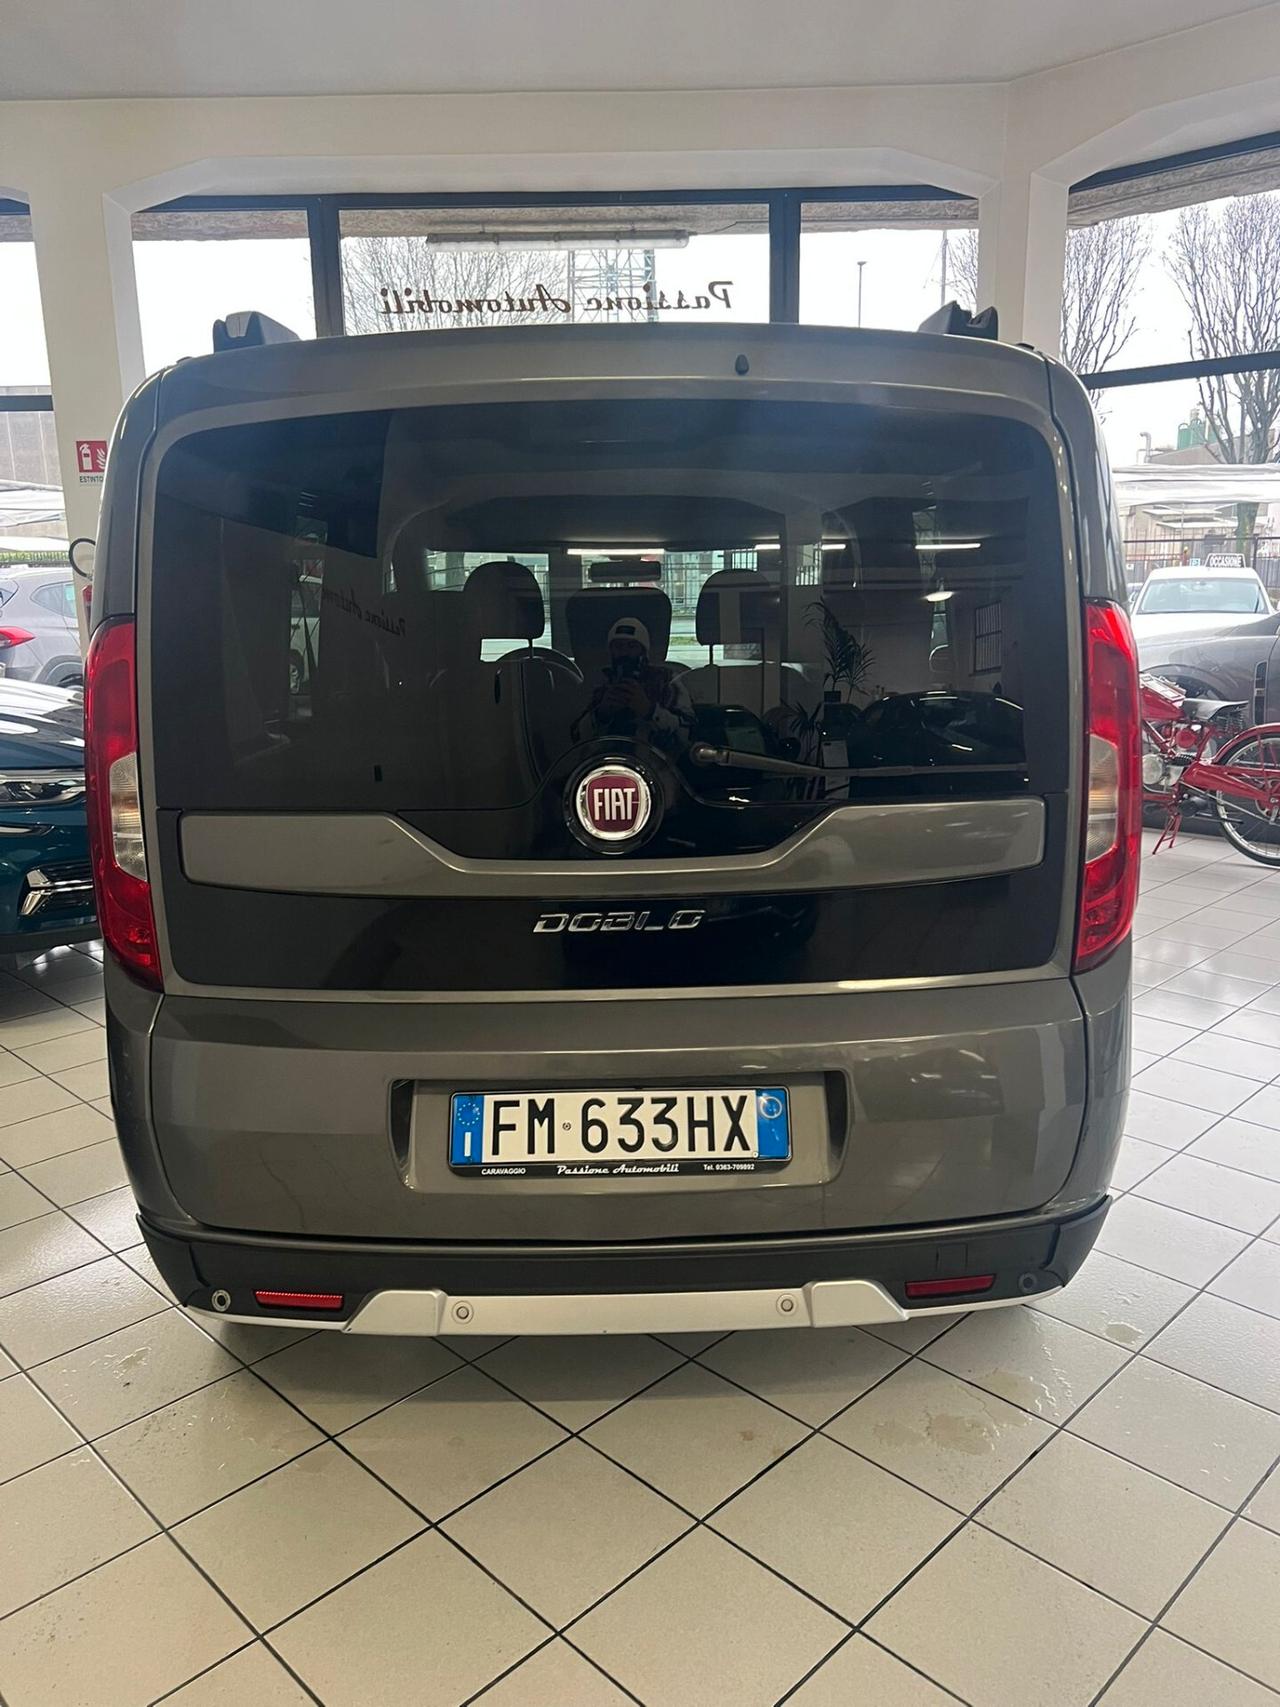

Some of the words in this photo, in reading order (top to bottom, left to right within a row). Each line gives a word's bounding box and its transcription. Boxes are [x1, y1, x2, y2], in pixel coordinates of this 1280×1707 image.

[1209, 556, 1242, 568] OCCASIONE
[592, 787, 636, 821] FIAT
[533, 910, 706, 933] DOBLO
[491, 1098, 556, 1156] FM
[580, 1094, 751, 1153] 633HX
[481, 1167, 527, 1176] CARAVAGGIO
[556, 1164, 609, 1175] Passione
[612, 1163, 680, 1174] Automobili
[703, 1163, 715, 1171] Tel.
